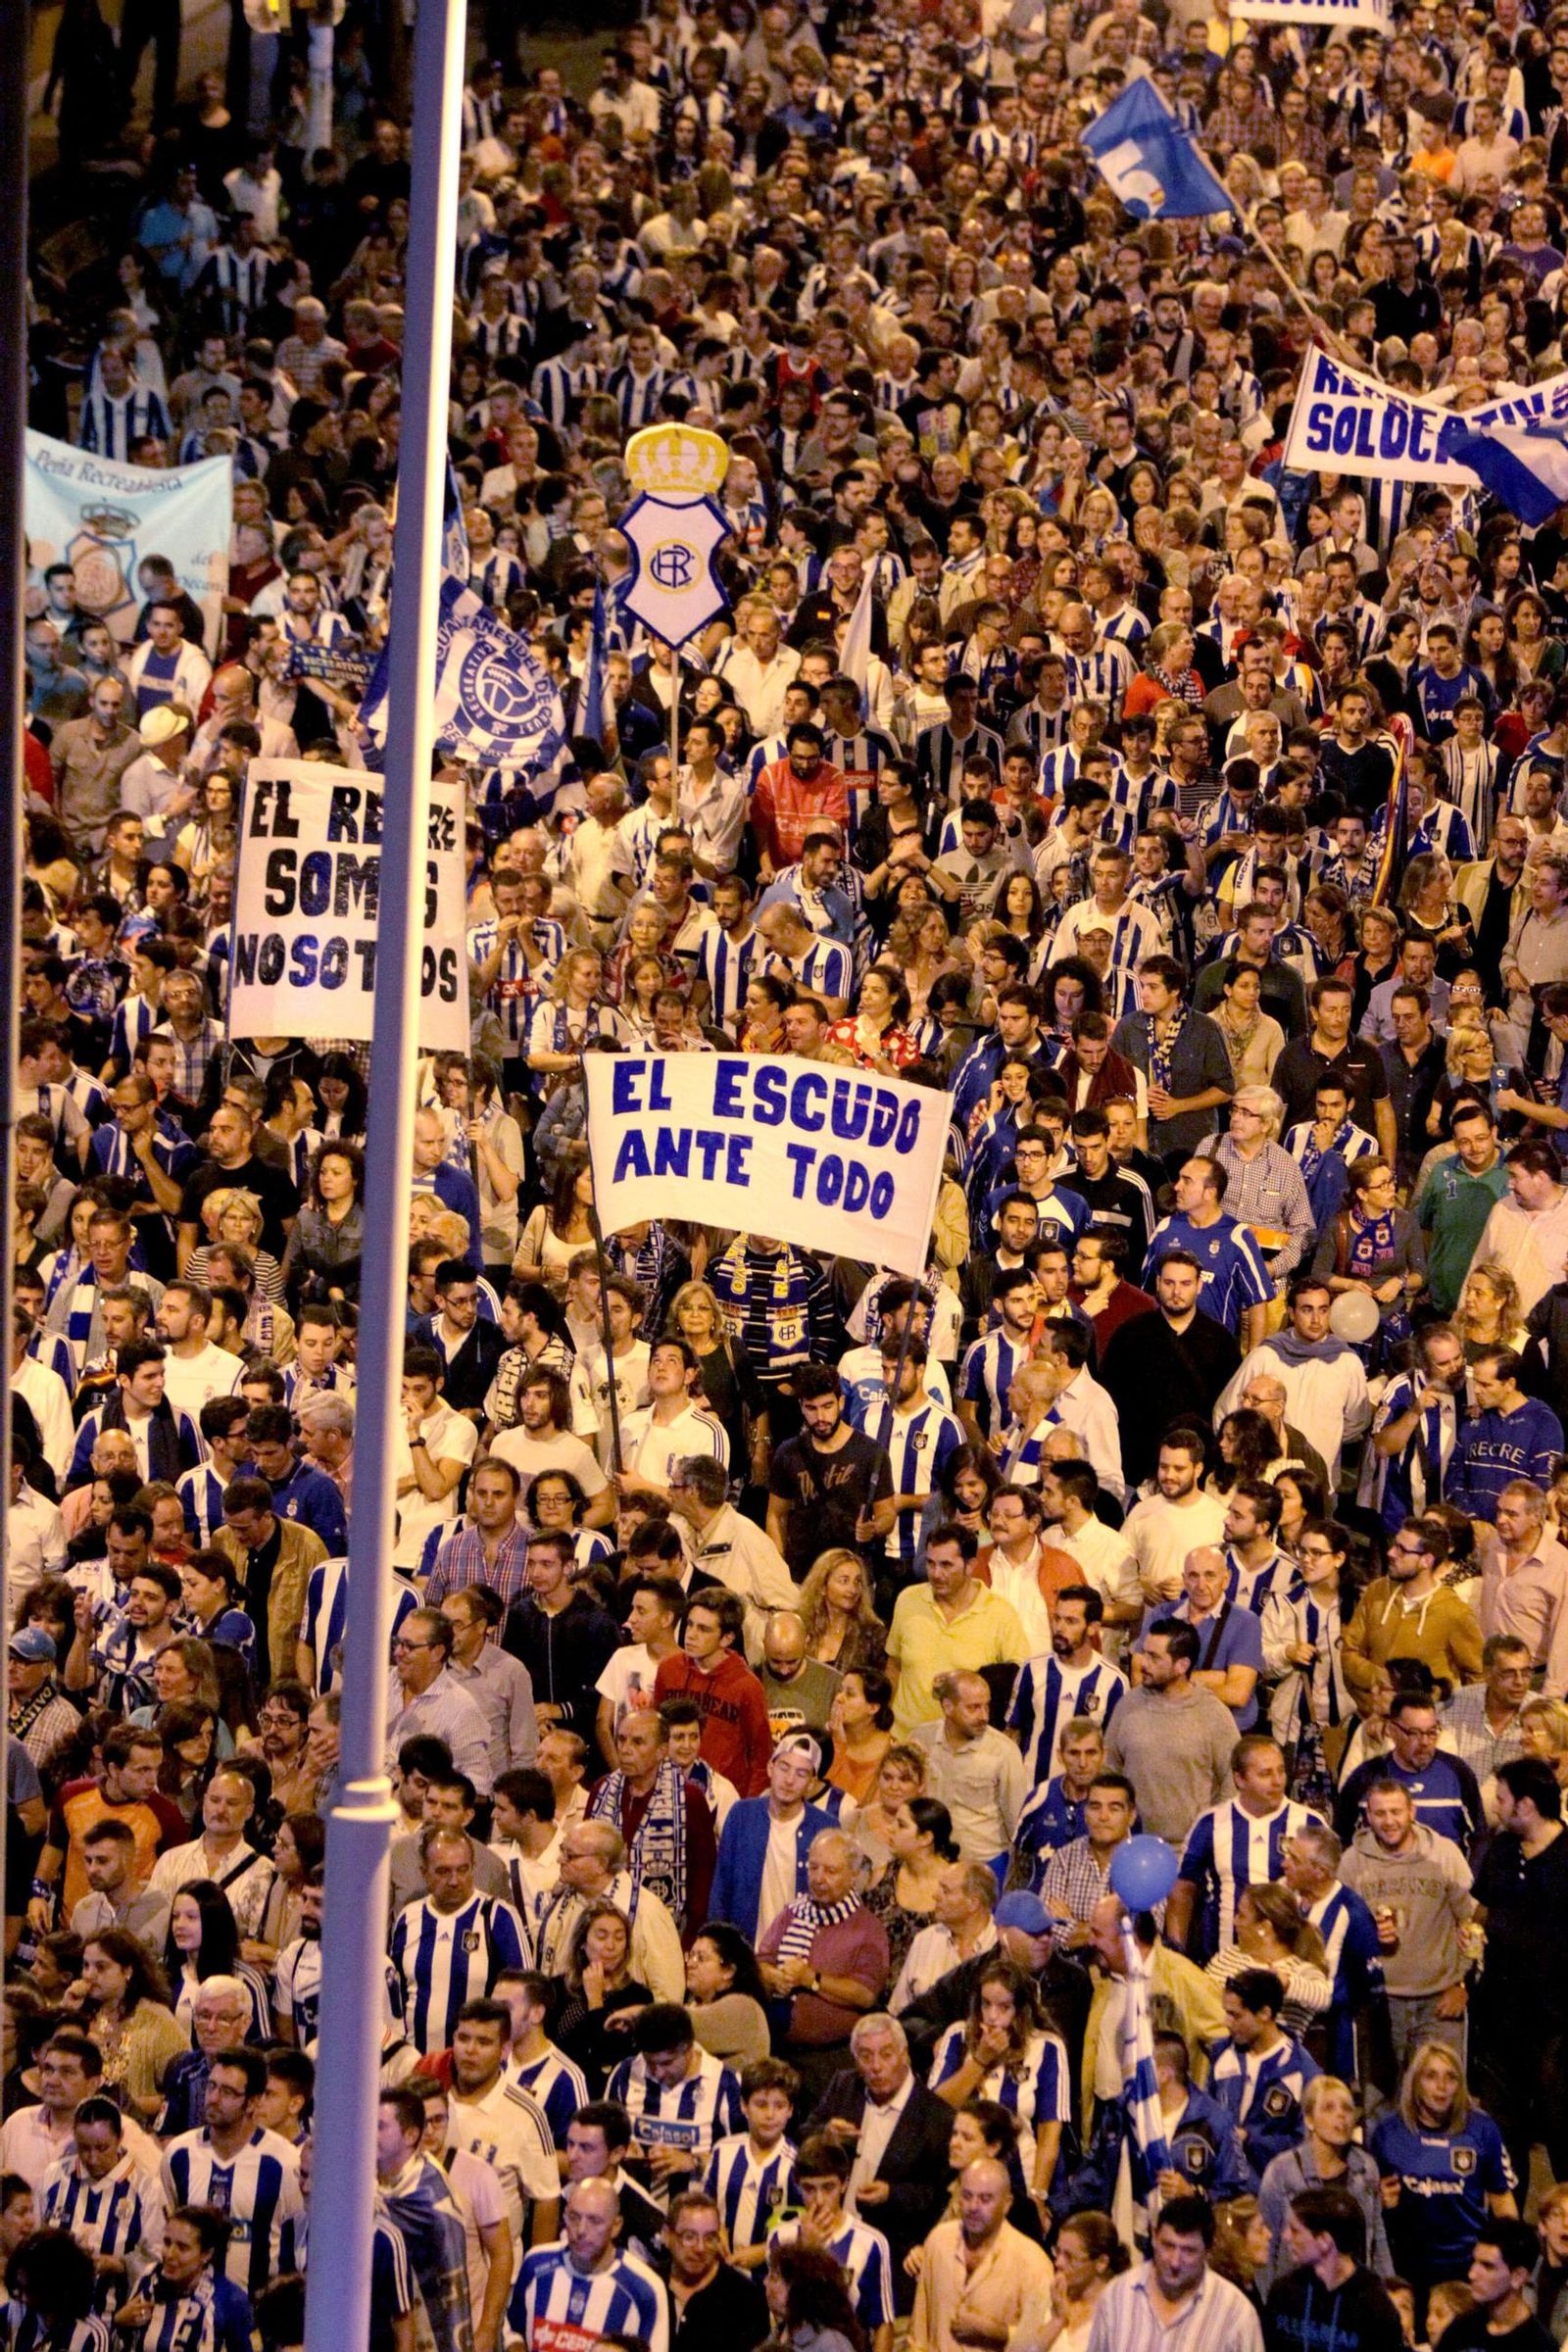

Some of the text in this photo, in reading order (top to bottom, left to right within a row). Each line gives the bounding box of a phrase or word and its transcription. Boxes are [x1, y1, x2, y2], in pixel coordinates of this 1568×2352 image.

[249, 780, 457, 852] EL RERE
[265, 848, 438, 928] SOMS
[233, 933, 458, 1003] NOSOTOS
[612, 1058, 922, 1154] EL ESCUDO
[612, 1127, 895, 1219] ANTE TODO
[1446, 1179, 1458, 1200] 1
[1470, 1441, 1526, 1465] RECRE
[638, 2121, 696, 2144] Cajasol
